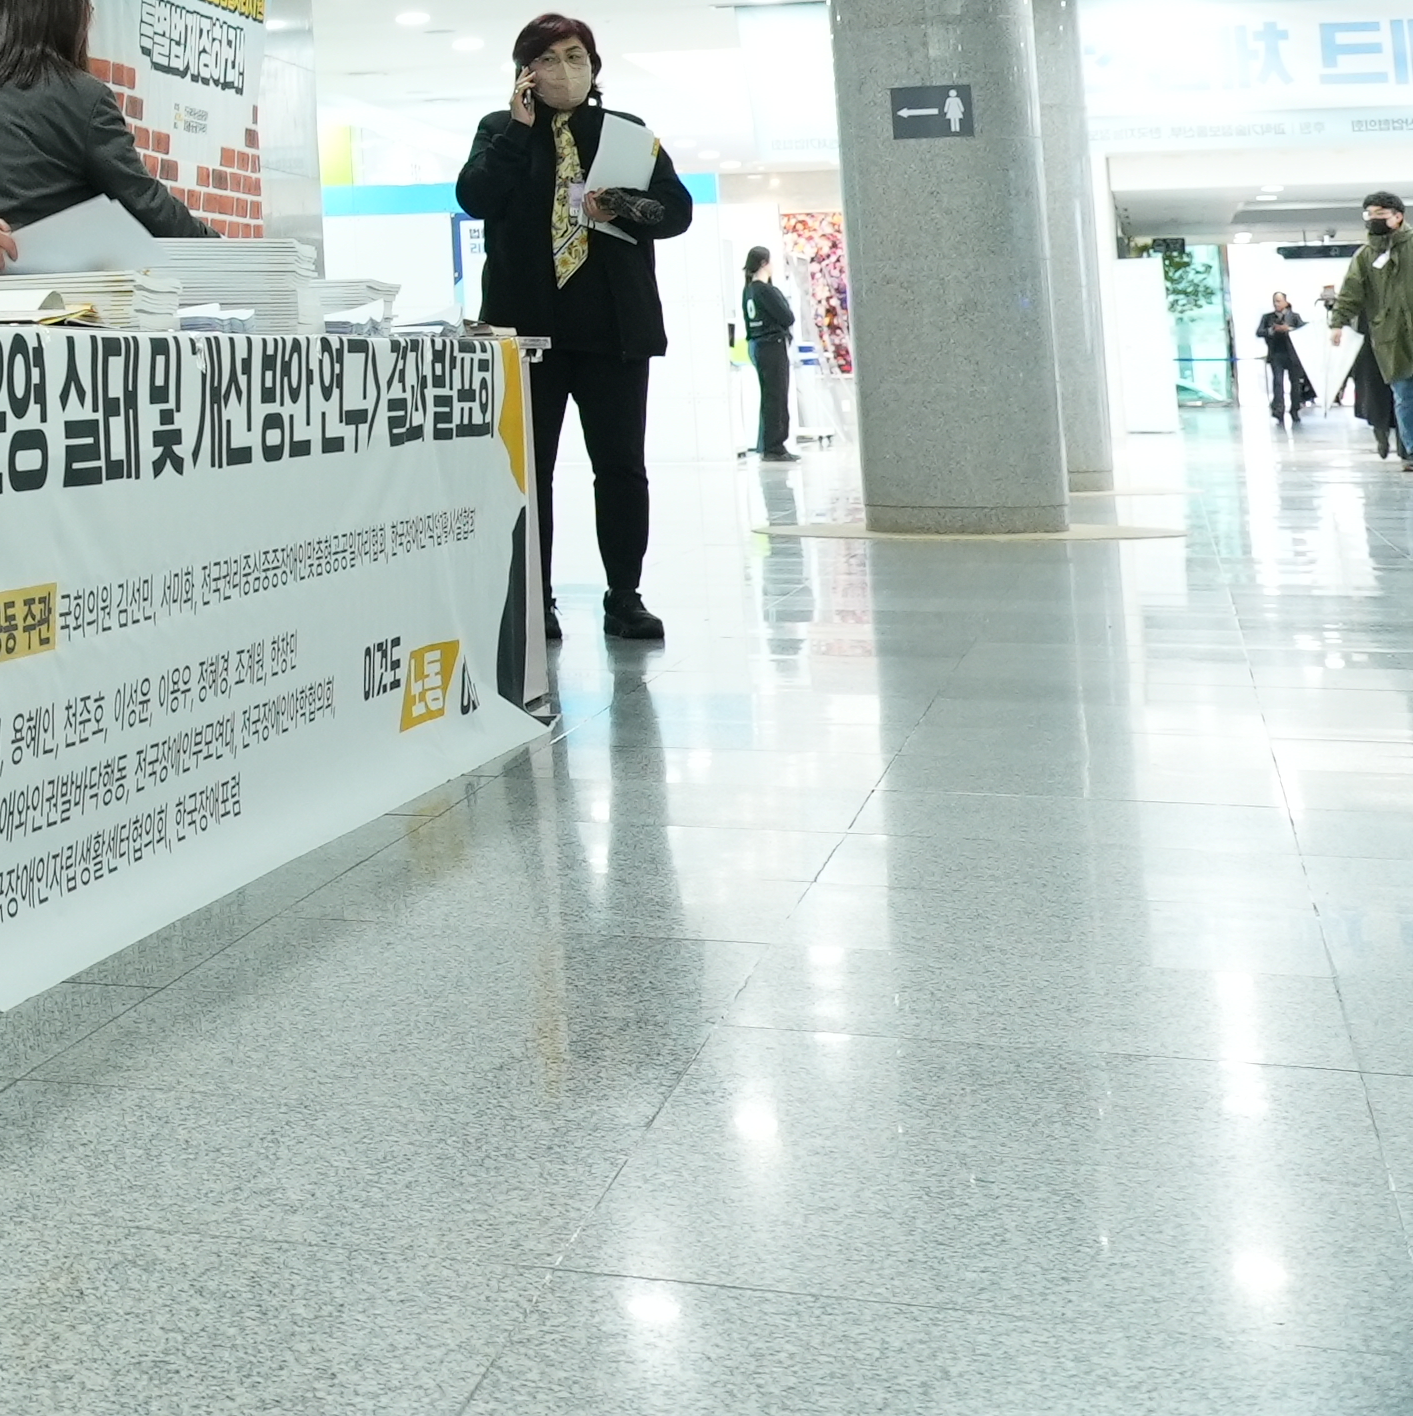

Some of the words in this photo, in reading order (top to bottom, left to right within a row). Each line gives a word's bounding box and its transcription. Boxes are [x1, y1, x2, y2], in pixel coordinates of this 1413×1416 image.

[59, 334, 141, 489] 실태
[150, 336, 184, 479] 및
[192, 335, 254, 472] 개선
[261, 336, 314, 463] 방안
[319, 336, 382, 456] 연구>
[386, 336, 427, 447] 결과
[430, 339, 496, 444] 발표회
[22, 590, 53, 652] 주관
[58, 582, 113, 642] 국회의원
[116, 573, 157, 627] 김선민,
[160, 563, 198, 616] 서미화,
[10, 702, 59, 765] 용혜인,
[63, 689, 109, 749] 천준호,
[113, 675, 153, 732] 이성윤,
[157, 664, 195, 714] 이용우,
[197, 649, 232, 704] 정혜경,
[234, 637, 267, 688] 조계원,
[270, 627, 299, 678] 한창민
[363, 635, 402, 702] 이것도
[410, 649, 444, 718] 노동
[133, 710, 238, 793] 전국장애인부모연대,
[240, 675, 337, 750] 전국장애인야학협의회,
[174, 771, 242, 843] 한국장애포럼
